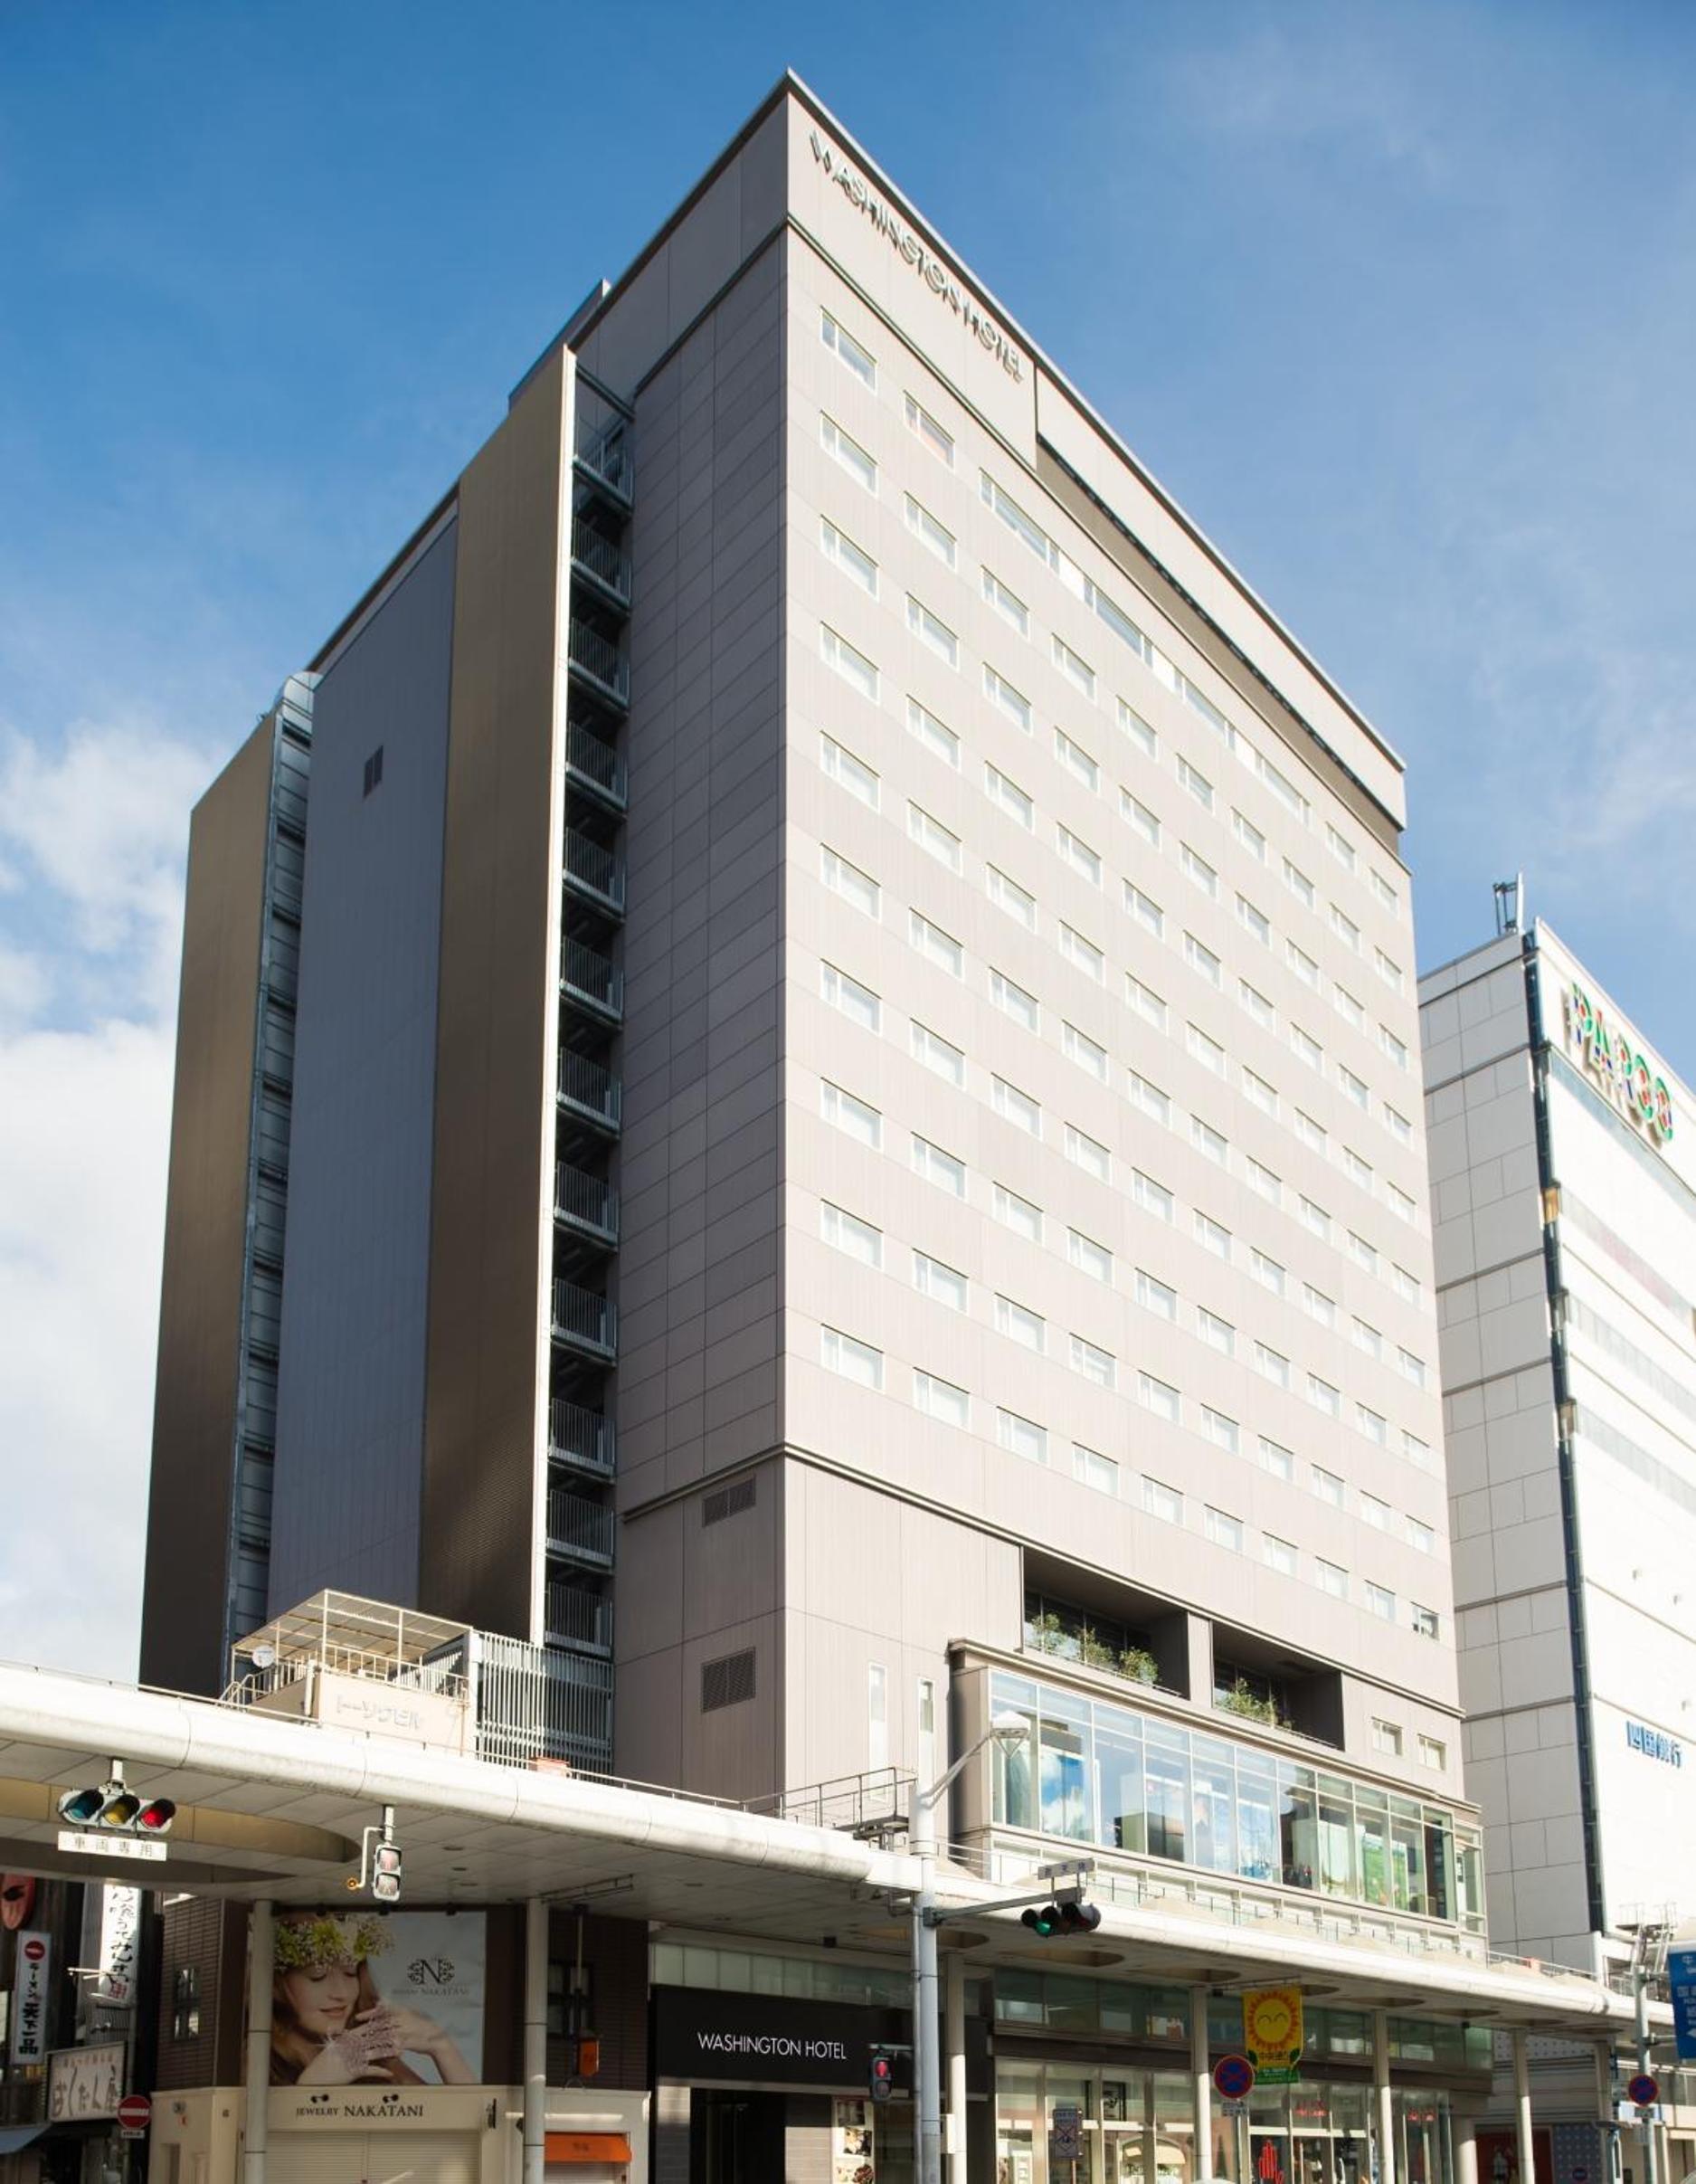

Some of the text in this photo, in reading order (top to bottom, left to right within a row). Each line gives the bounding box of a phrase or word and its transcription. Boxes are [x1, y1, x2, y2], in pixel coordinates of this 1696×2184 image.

[810, 129, 1024, 385] WASHINGTON HOTEL
[1569, 982, 1673, 1141] PARCO
[1626, 1721, 1681, 1769] 四国銀行
[18, 2002, 41, 2055] 天下一品
[697, 2031, 847, 2060] WASHINGTON HOTEL
[296, 2104, 424, 2118] JEWELRY NAKATANI
